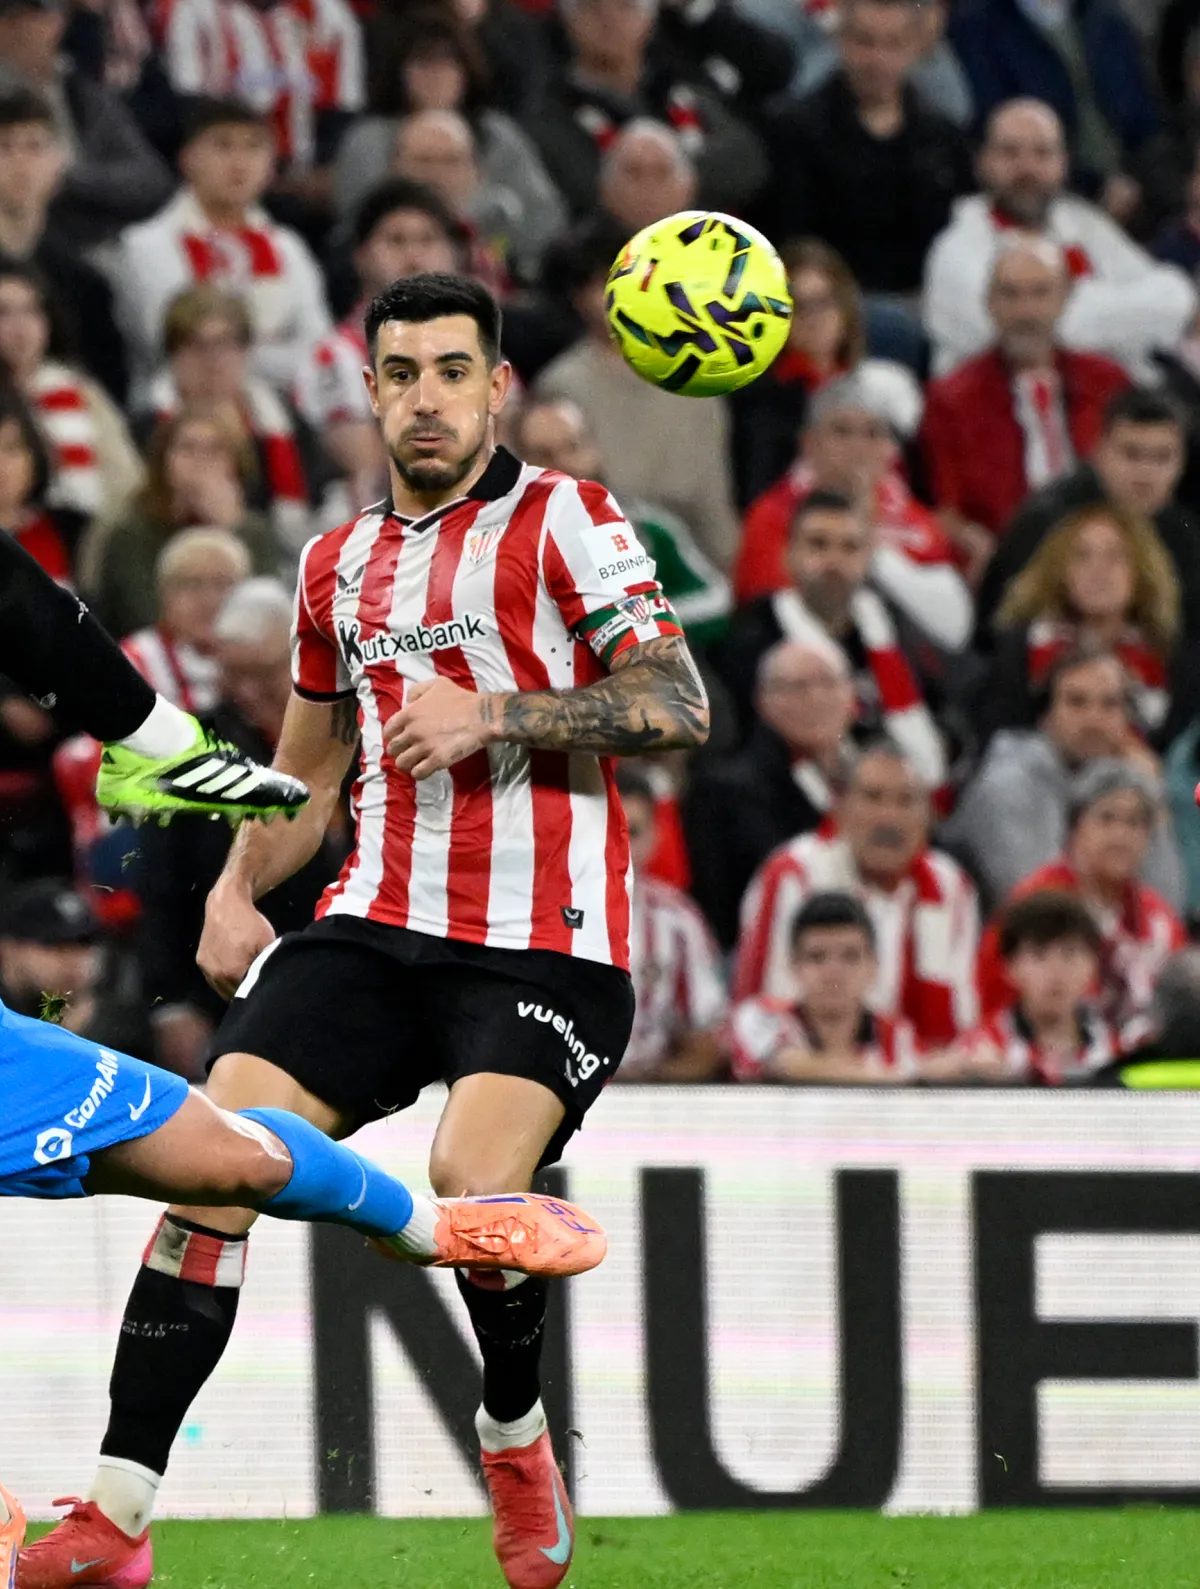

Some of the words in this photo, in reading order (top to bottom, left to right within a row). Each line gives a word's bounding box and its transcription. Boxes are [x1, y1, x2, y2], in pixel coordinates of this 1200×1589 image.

[338, 614, 486, 671] Kutxabank
[517, 1001, 601, 1080] vueling
[310, 1165, 1200, 1512] NUE
